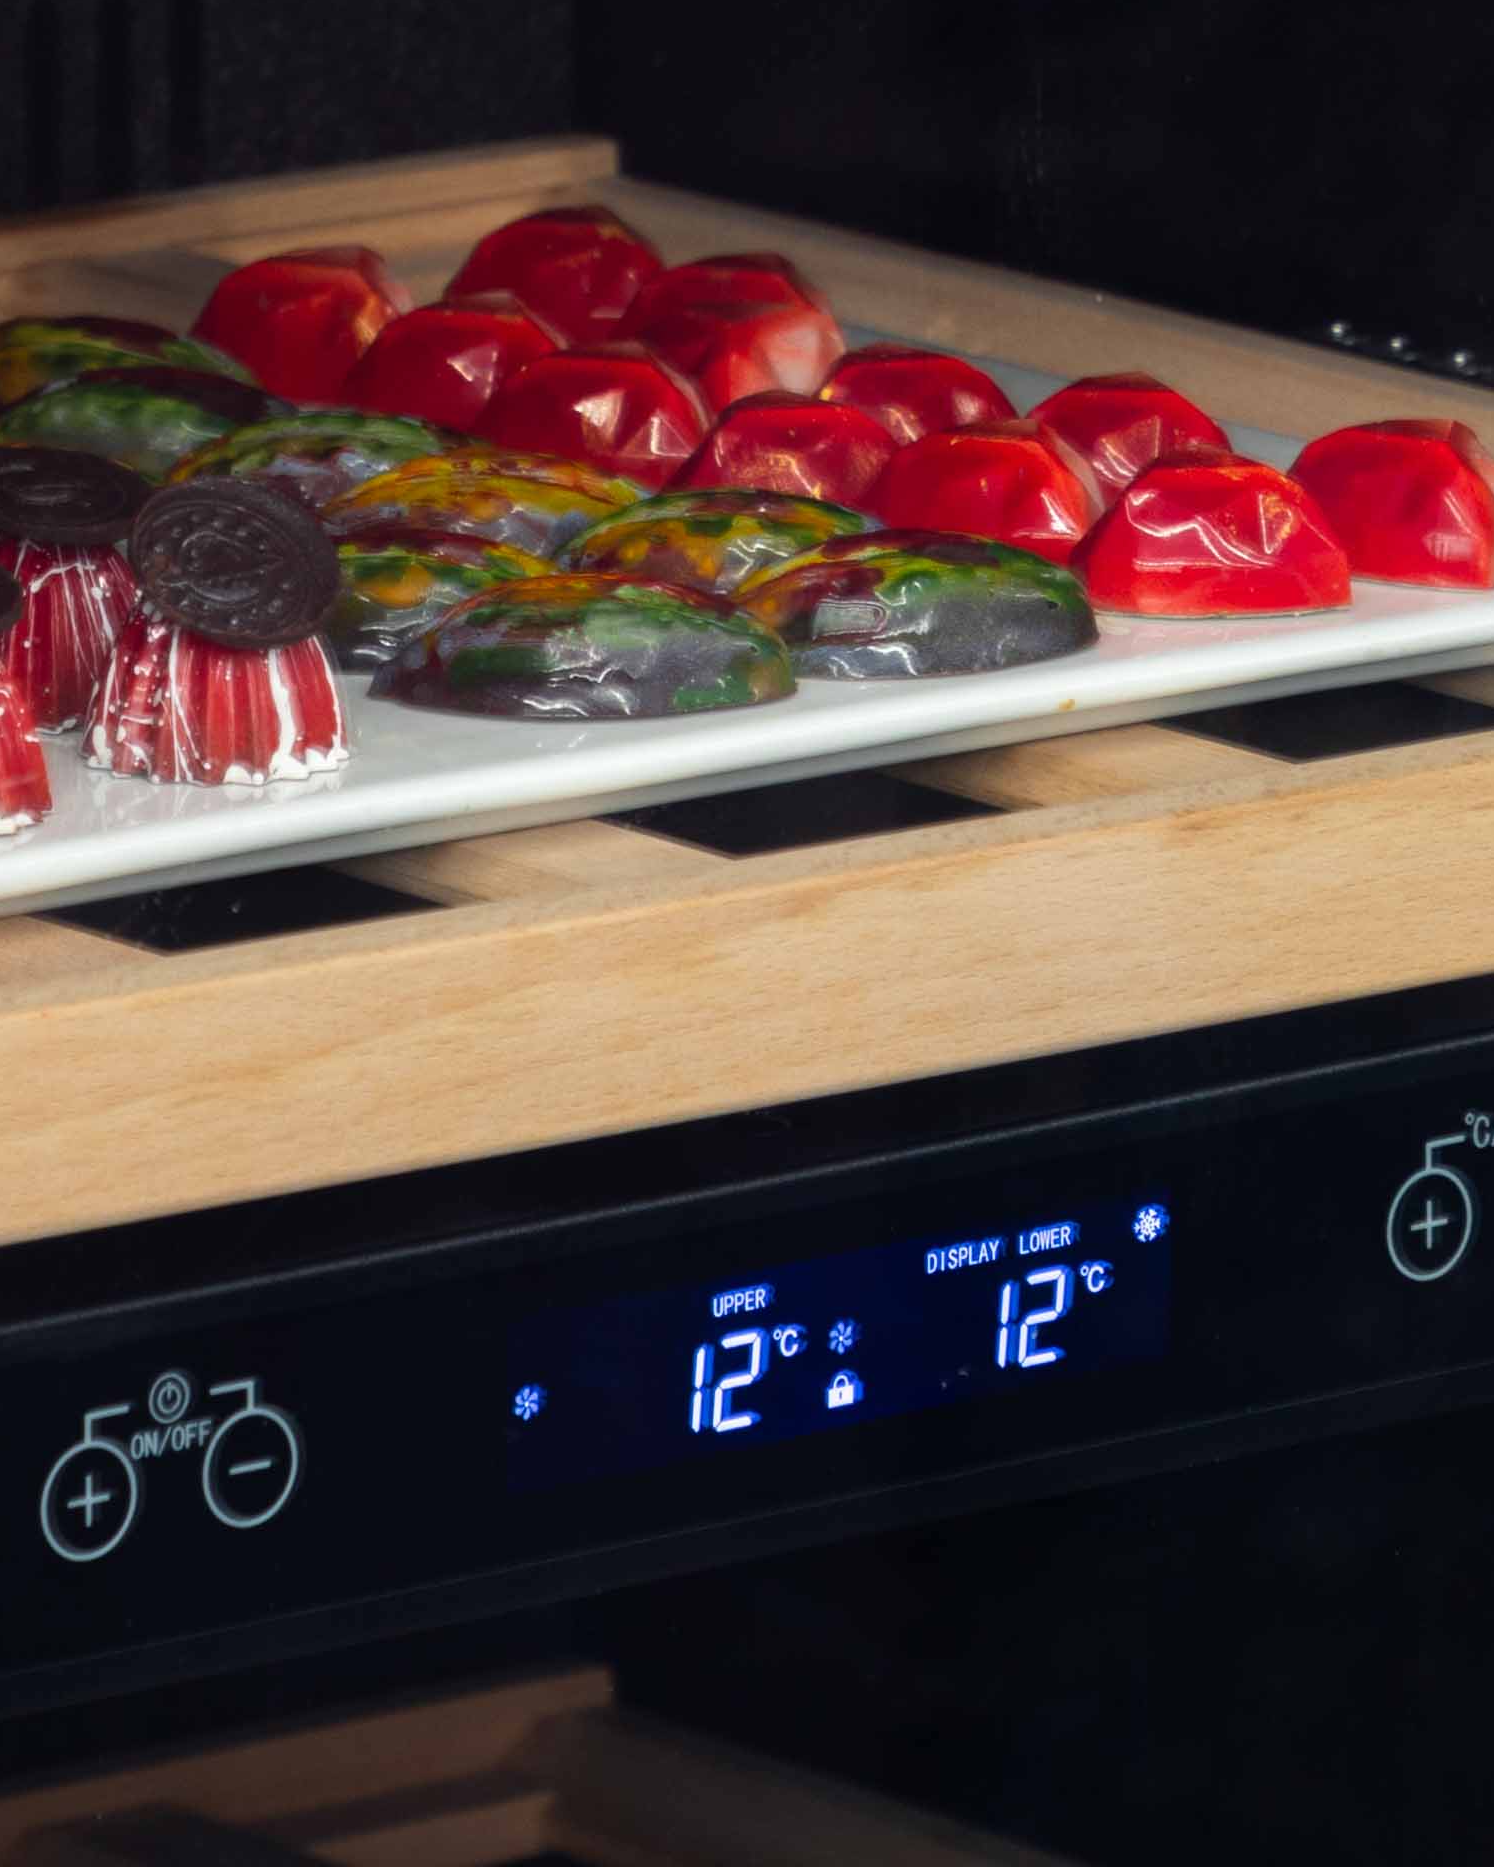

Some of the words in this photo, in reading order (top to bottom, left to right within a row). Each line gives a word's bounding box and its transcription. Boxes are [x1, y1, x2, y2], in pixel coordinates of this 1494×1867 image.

[925, 1238, 1001, 1275] DISPLAY
[1017, 1224, 1074, 1257] LOWER
[712, 1286, 768, 1319] UPPER
[130, 1419, 212, 1460] ON/OFF
